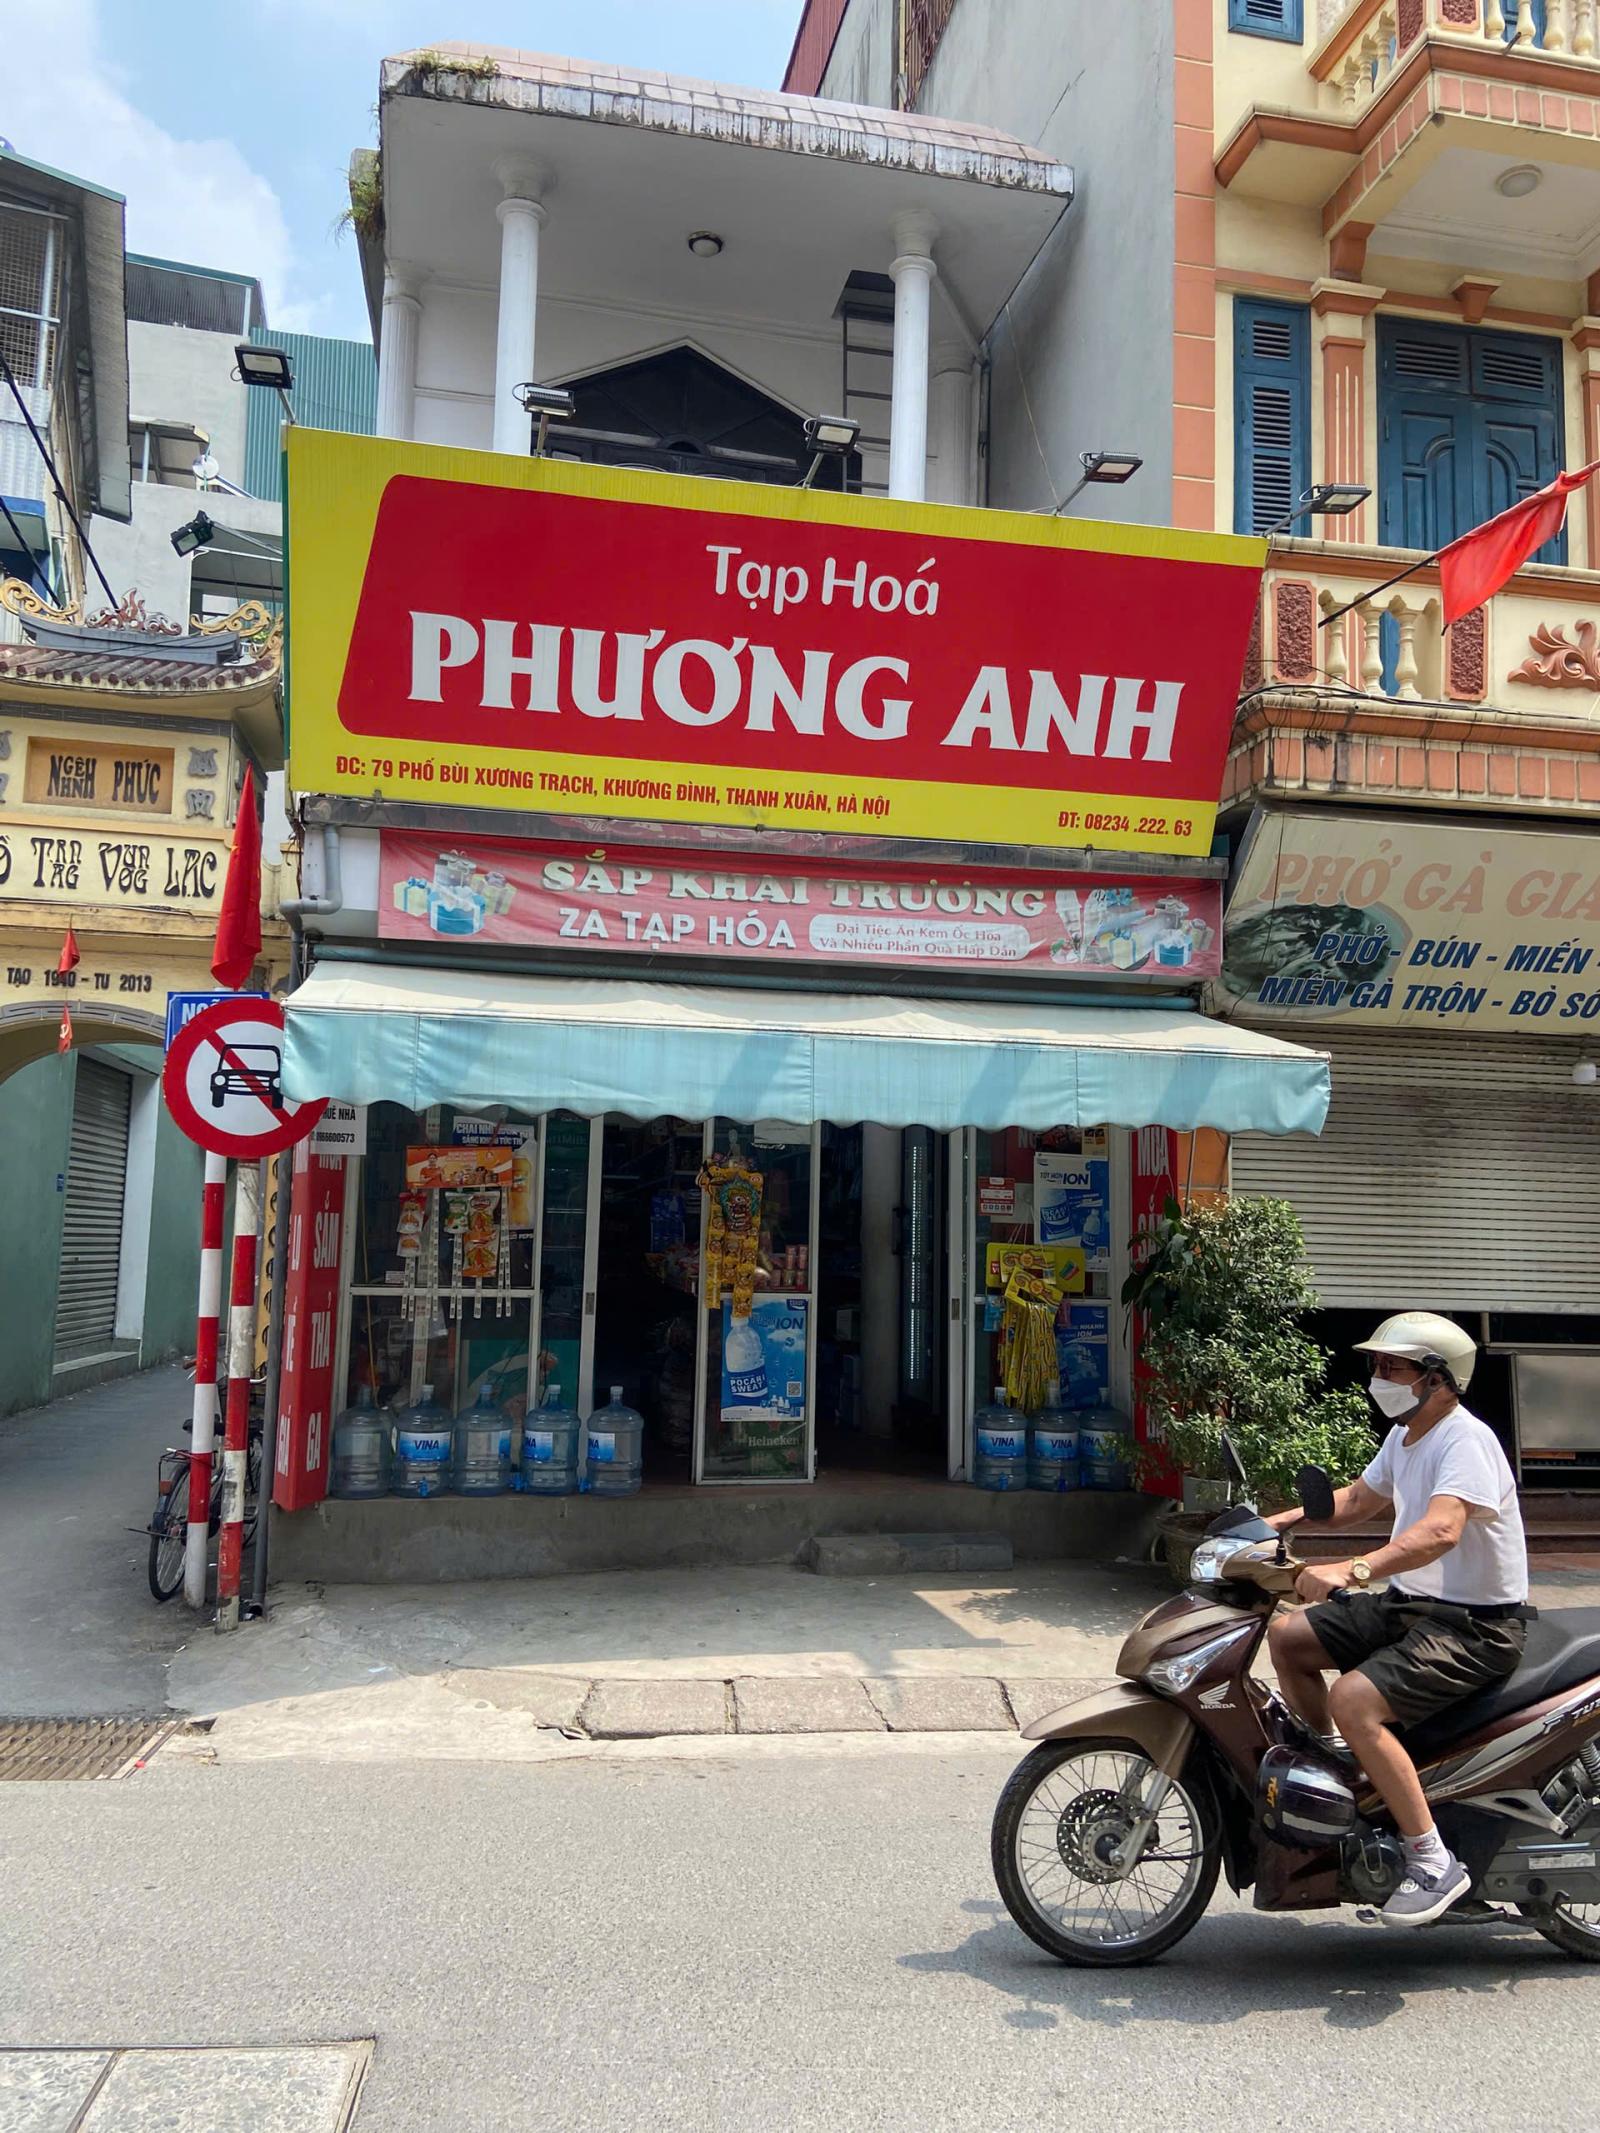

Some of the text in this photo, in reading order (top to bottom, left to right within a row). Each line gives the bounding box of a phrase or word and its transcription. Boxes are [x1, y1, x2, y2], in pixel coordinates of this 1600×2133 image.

[706, 545, 939, 616] Tạp Hoá
[407, 611, 1185, 763] PHƯƠNG ANH
[112, 758, 161, 804] PHÚC
[336, 755, 891, 819] ĐC: 79 PHỐ BÙI XƯƠNG TRẠCH, KHƯƠNG ĐÌNH, THANH XUÂN, HÀ NỘI
[1058, 811, 1081, 829] ĐT:
[1084, 813, 1130, 832] 08234
[1174, 819, 1192, 836] 63
[164, 847, 217, 898] LẠC
[1258, 839, 1402, 907] PHỞ
[1403, 850, 1493, 914] GÀ
[668, 871, 810, 905] KHAI
[825, 879, 1047, 917] TRƯƠNG
[560, 908, 796, 950] ZA TẠP HÓA
[919, 927, 949, 939] Kem
[1312, 924, 1389, 965] PHỞ
[1408, 935, 1482, 969] BÚN
[1504, 938, 1594, 975] MIẾN
[119, 974, 152, 993] 2013
[1350, 977, 1394, 1009] GÀ
[1401, 981, 1487, 1018] TRỘN
[1508, 984, 1557, 1017] BÒ
[1137, 1126, 1169, 1177] MUA
[1063, 1172, 1089, 1185] ION
[776, 1317, 804, 1330] ION
[731, 1382, 762, 1393] SWEAT
[414, 1439, 440, 1450] VINA
[991, 1436, 1015, 1448] VINA
[1051, 1439, 1073, 1449] VINA
[1200, 1702, 1237, 1710] HONDA
